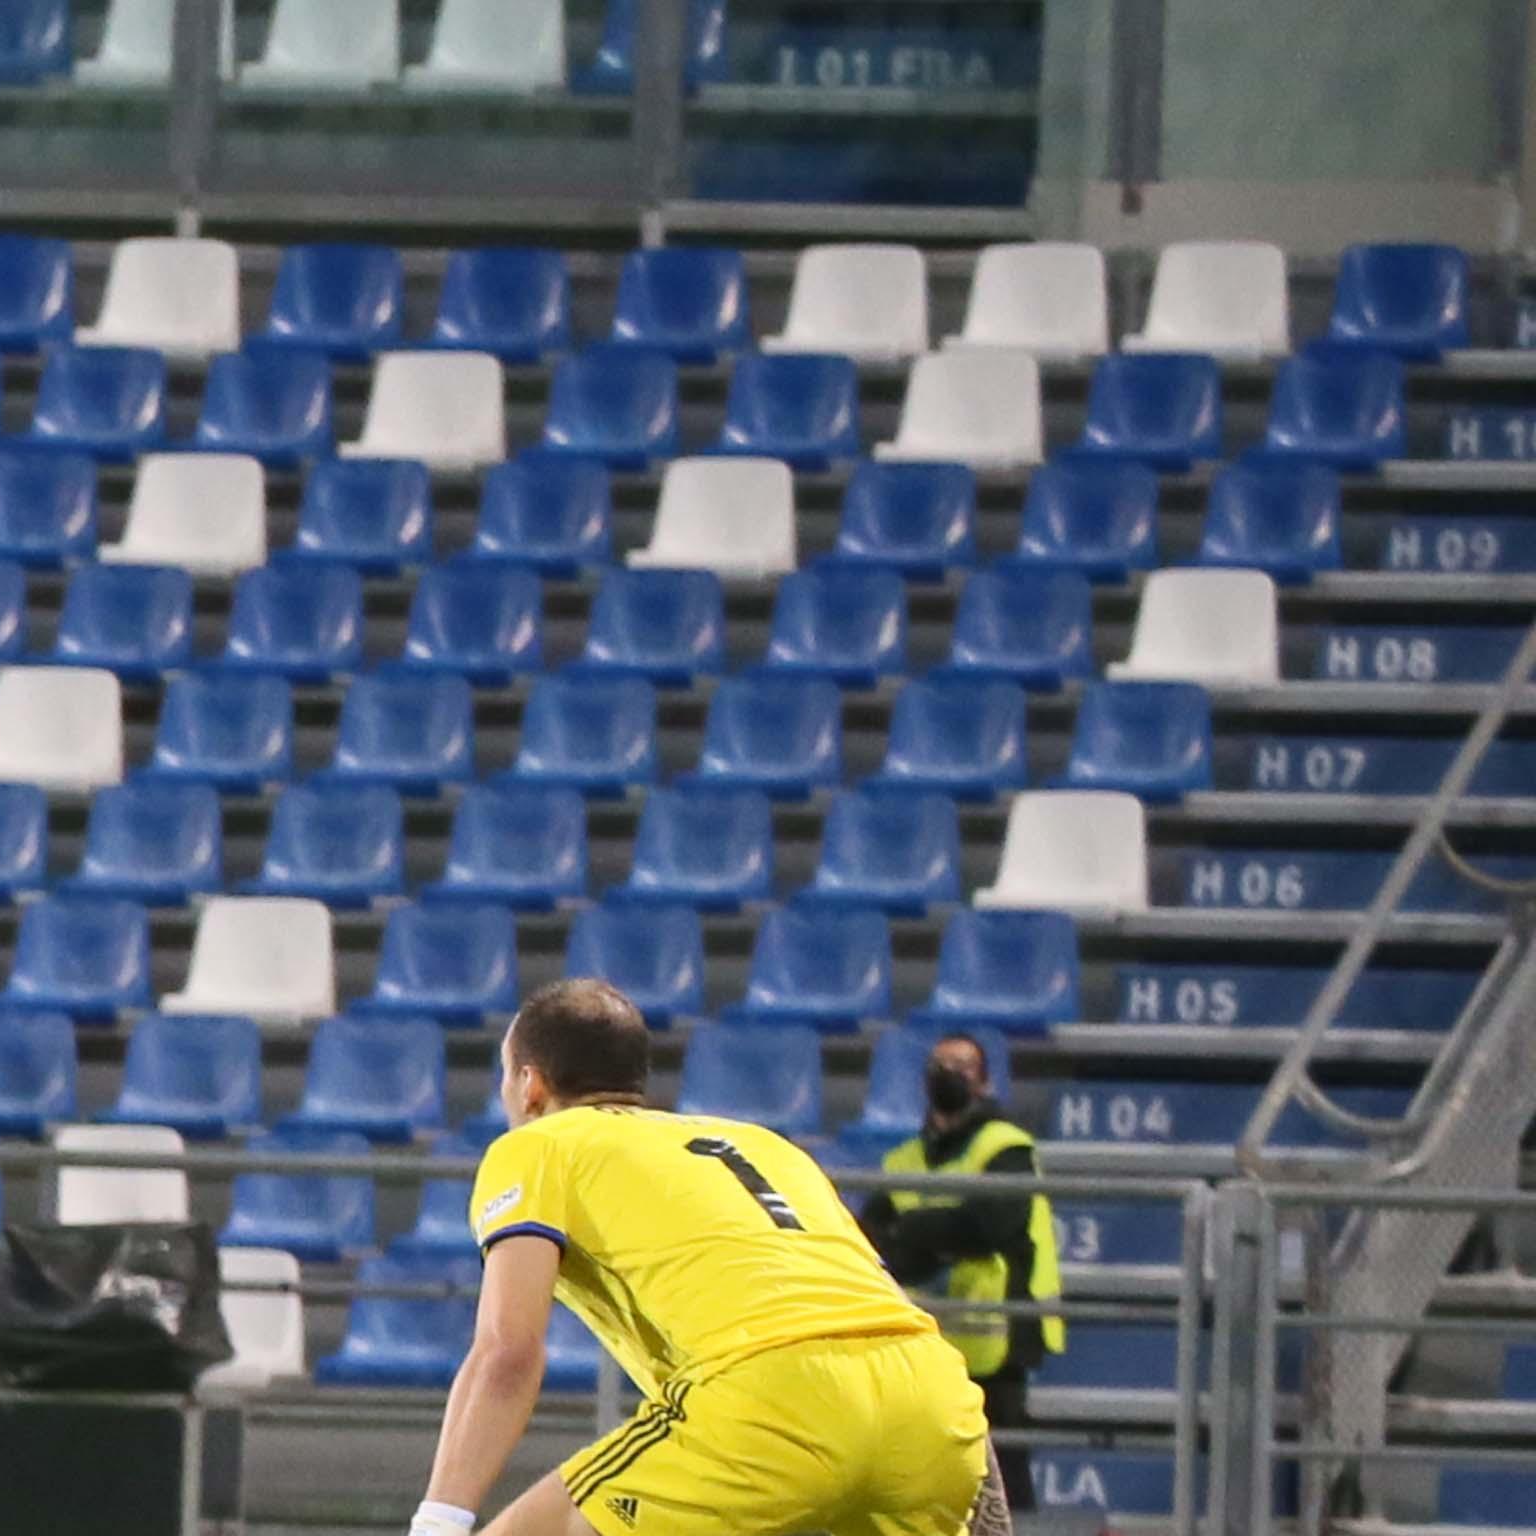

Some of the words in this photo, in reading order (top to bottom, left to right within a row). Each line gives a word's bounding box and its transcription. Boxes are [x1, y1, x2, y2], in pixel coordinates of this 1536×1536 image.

[1450, 418, 1481, 456] H
[1503, 417, 1536, 457] 1
[1391, 526, 1422, 568] H
[1438, 529, 1498, 570] 09
[1328, 636, 1359, 678] H
[1374, 638, 1438, 679] 08
[1257, 747, 1289, 786] H
[1305, 748, 1367, 788] 07
[1192, 862, 1227, 902] H
[1240, 864, 1305, 907] 06
[1127, 978, 1164, 1020] H
[1176, 979, 1239, 1022] 05
[1058, 1093, 1092, 1135] H
[1109, 1095, 1173, 1136] 04
[684, 1137, 807, 1232] 1
